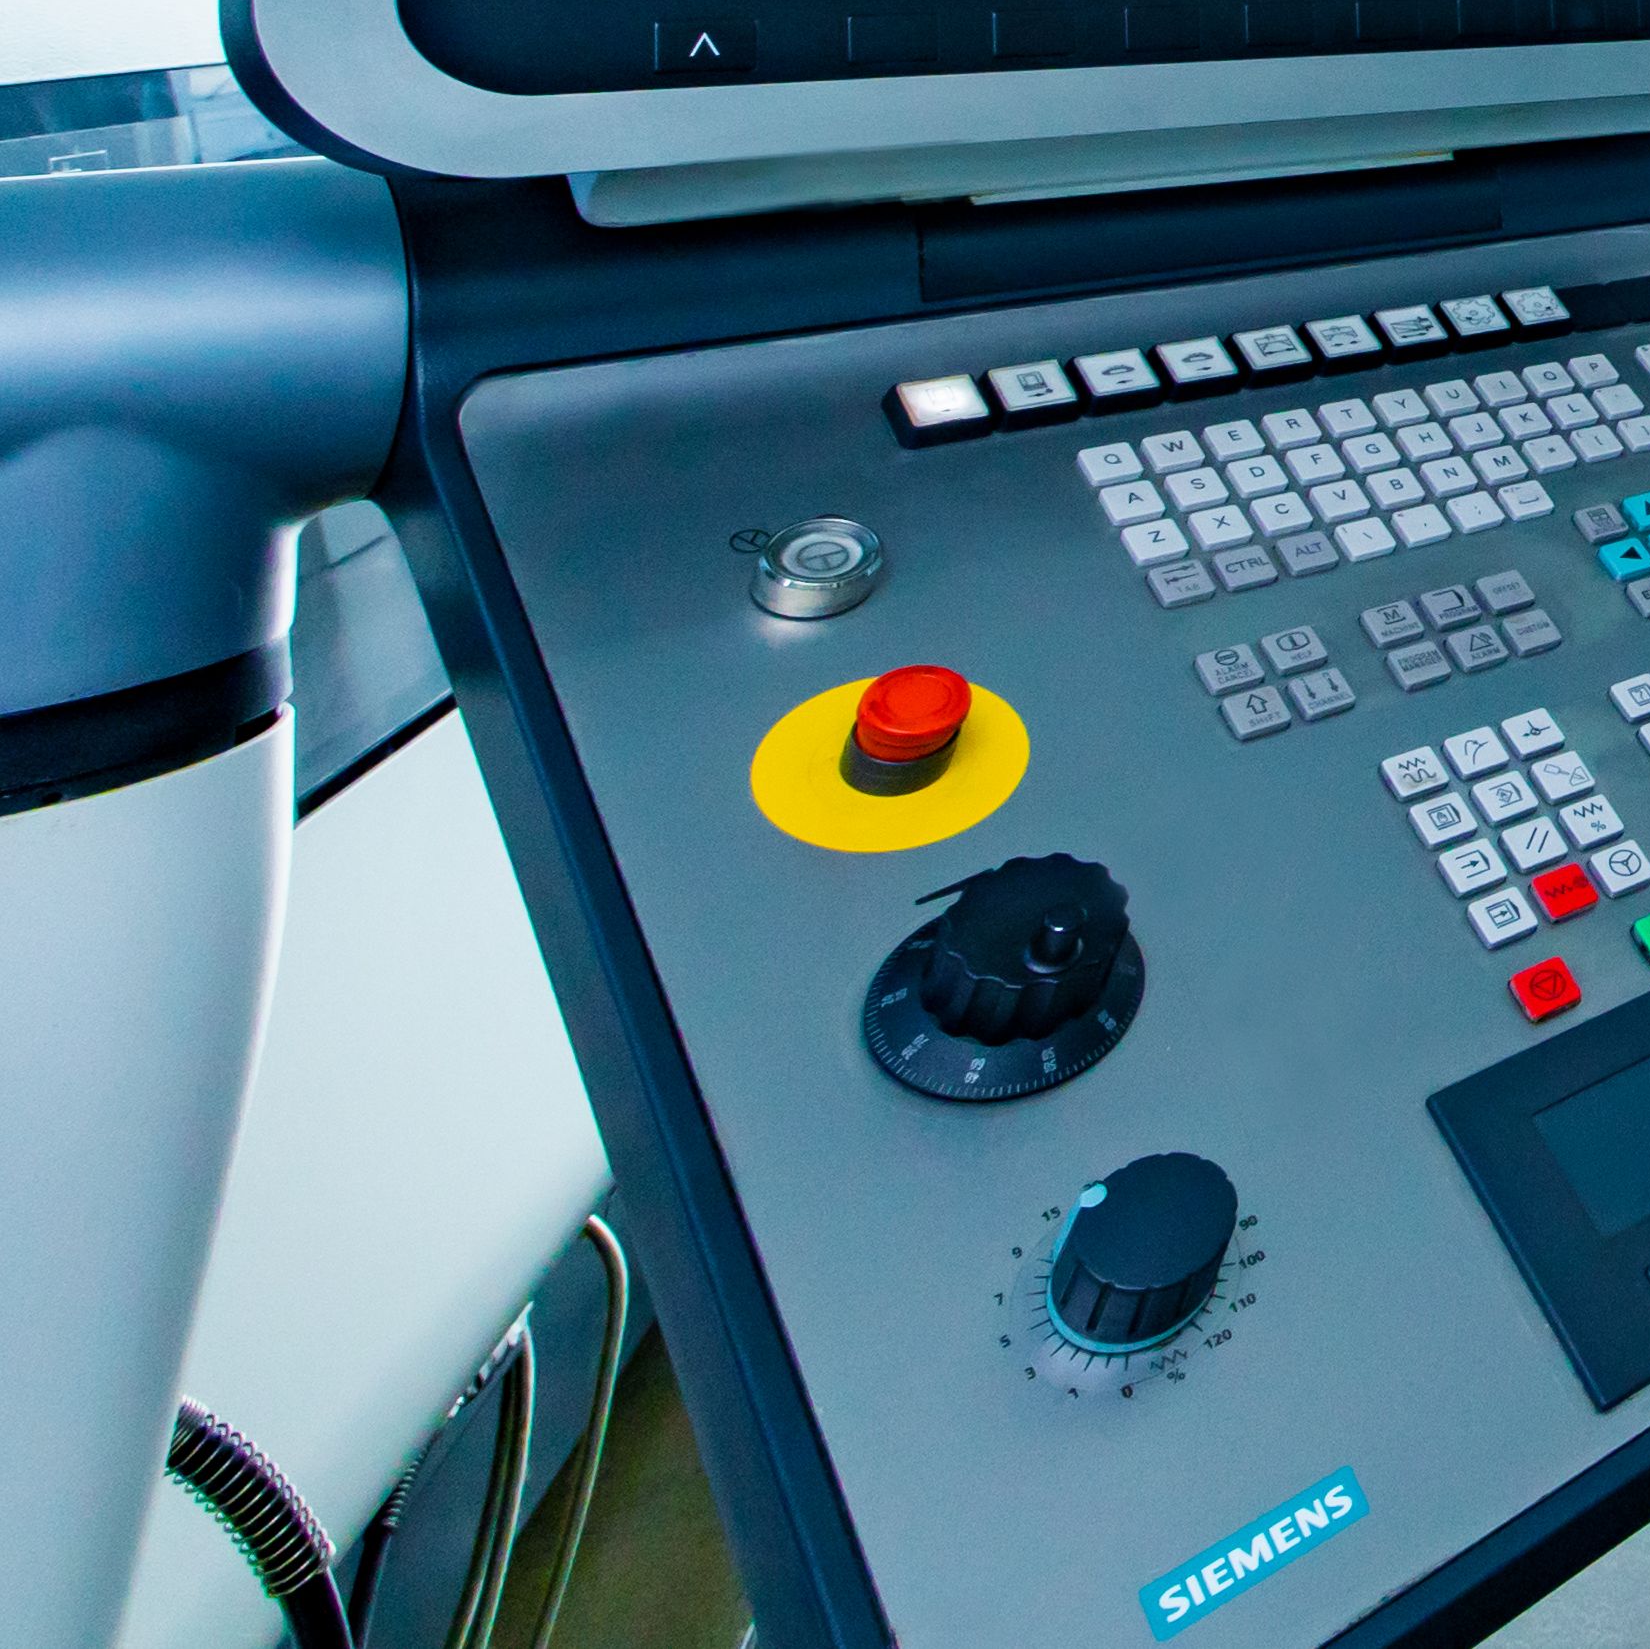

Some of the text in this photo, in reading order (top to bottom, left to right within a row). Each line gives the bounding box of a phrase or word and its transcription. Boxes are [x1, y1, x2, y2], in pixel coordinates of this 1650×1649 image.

[1448, 388, 1460, 399] U
[1394, 398, 1407, 410] Y
[1567, 403, 1580, 413] L
[1341, 409, 1354, 421] T
[1518, 412, 1534, 423] K
[1286, 418, 1302, 430] R
[1228, 430, 1240, 442] E
[1417, 432, 1433, 444] H
[1160, 439, 1184, 454] W
[1365, 442, 1381, 455] G
[1104, 453, 1121, 466] Q
[1310, 453, 1323, 466] F
[1492, 455, 1511, 467] M
[1249, 466, 1265, 478] D
[1443, 467, 1459, 479] N
[1191, 478, 1206, 490] S
[1389, 479, 1404, 491] B
[1127, 491, 1144, 504] A
[1333, 489, 1347, 501] V
[1276, 503, 1290, 515] C
[1215, 515, 1231, 530] X
[1150, 531, 1166, 543] Z
[1294, 542, 1323, 558] ALT
[1224, 555, 1271, 574] CTRL
[1381, 621, 1420, 638] MACHINE
[1214, 661, 1250, 676] ALARM
[1041, 1207, 1061, 1222] 15
[1239, 1214, 1259, 1231] 90
[1238, 1250, 1266, 1269] 100
[1229, 1292, 1257, 1313] 110
[1203, 1329, 1233, 1350] 120
[1158, 1484, 1353, 1624] SIEMENS
